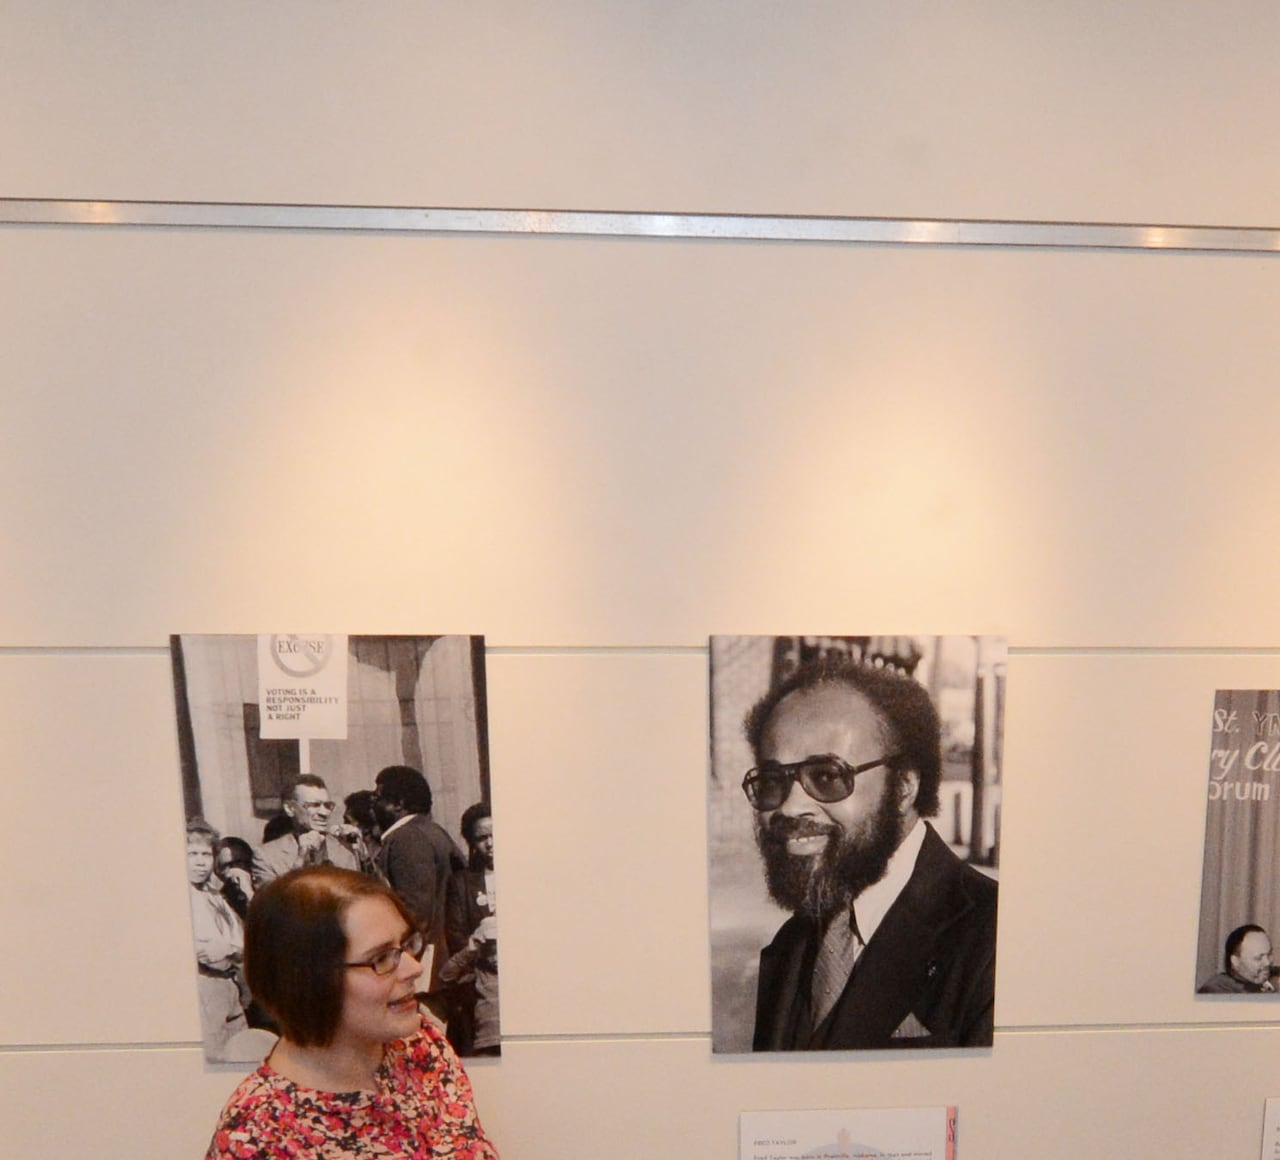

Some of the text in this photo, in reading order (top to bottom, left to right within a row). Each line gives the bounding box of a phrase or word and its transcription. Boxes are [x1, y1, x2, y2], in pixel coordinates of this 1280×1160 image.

[278, 640, 325, 654] EXCSE
[266, 688, 317, 696] VOTING IS A
[266, 696, 339, 704] RESPONSIBILITY
[266, 704, 307, 712] NOT JUST
[1214, 708, 1239, 733] St.
